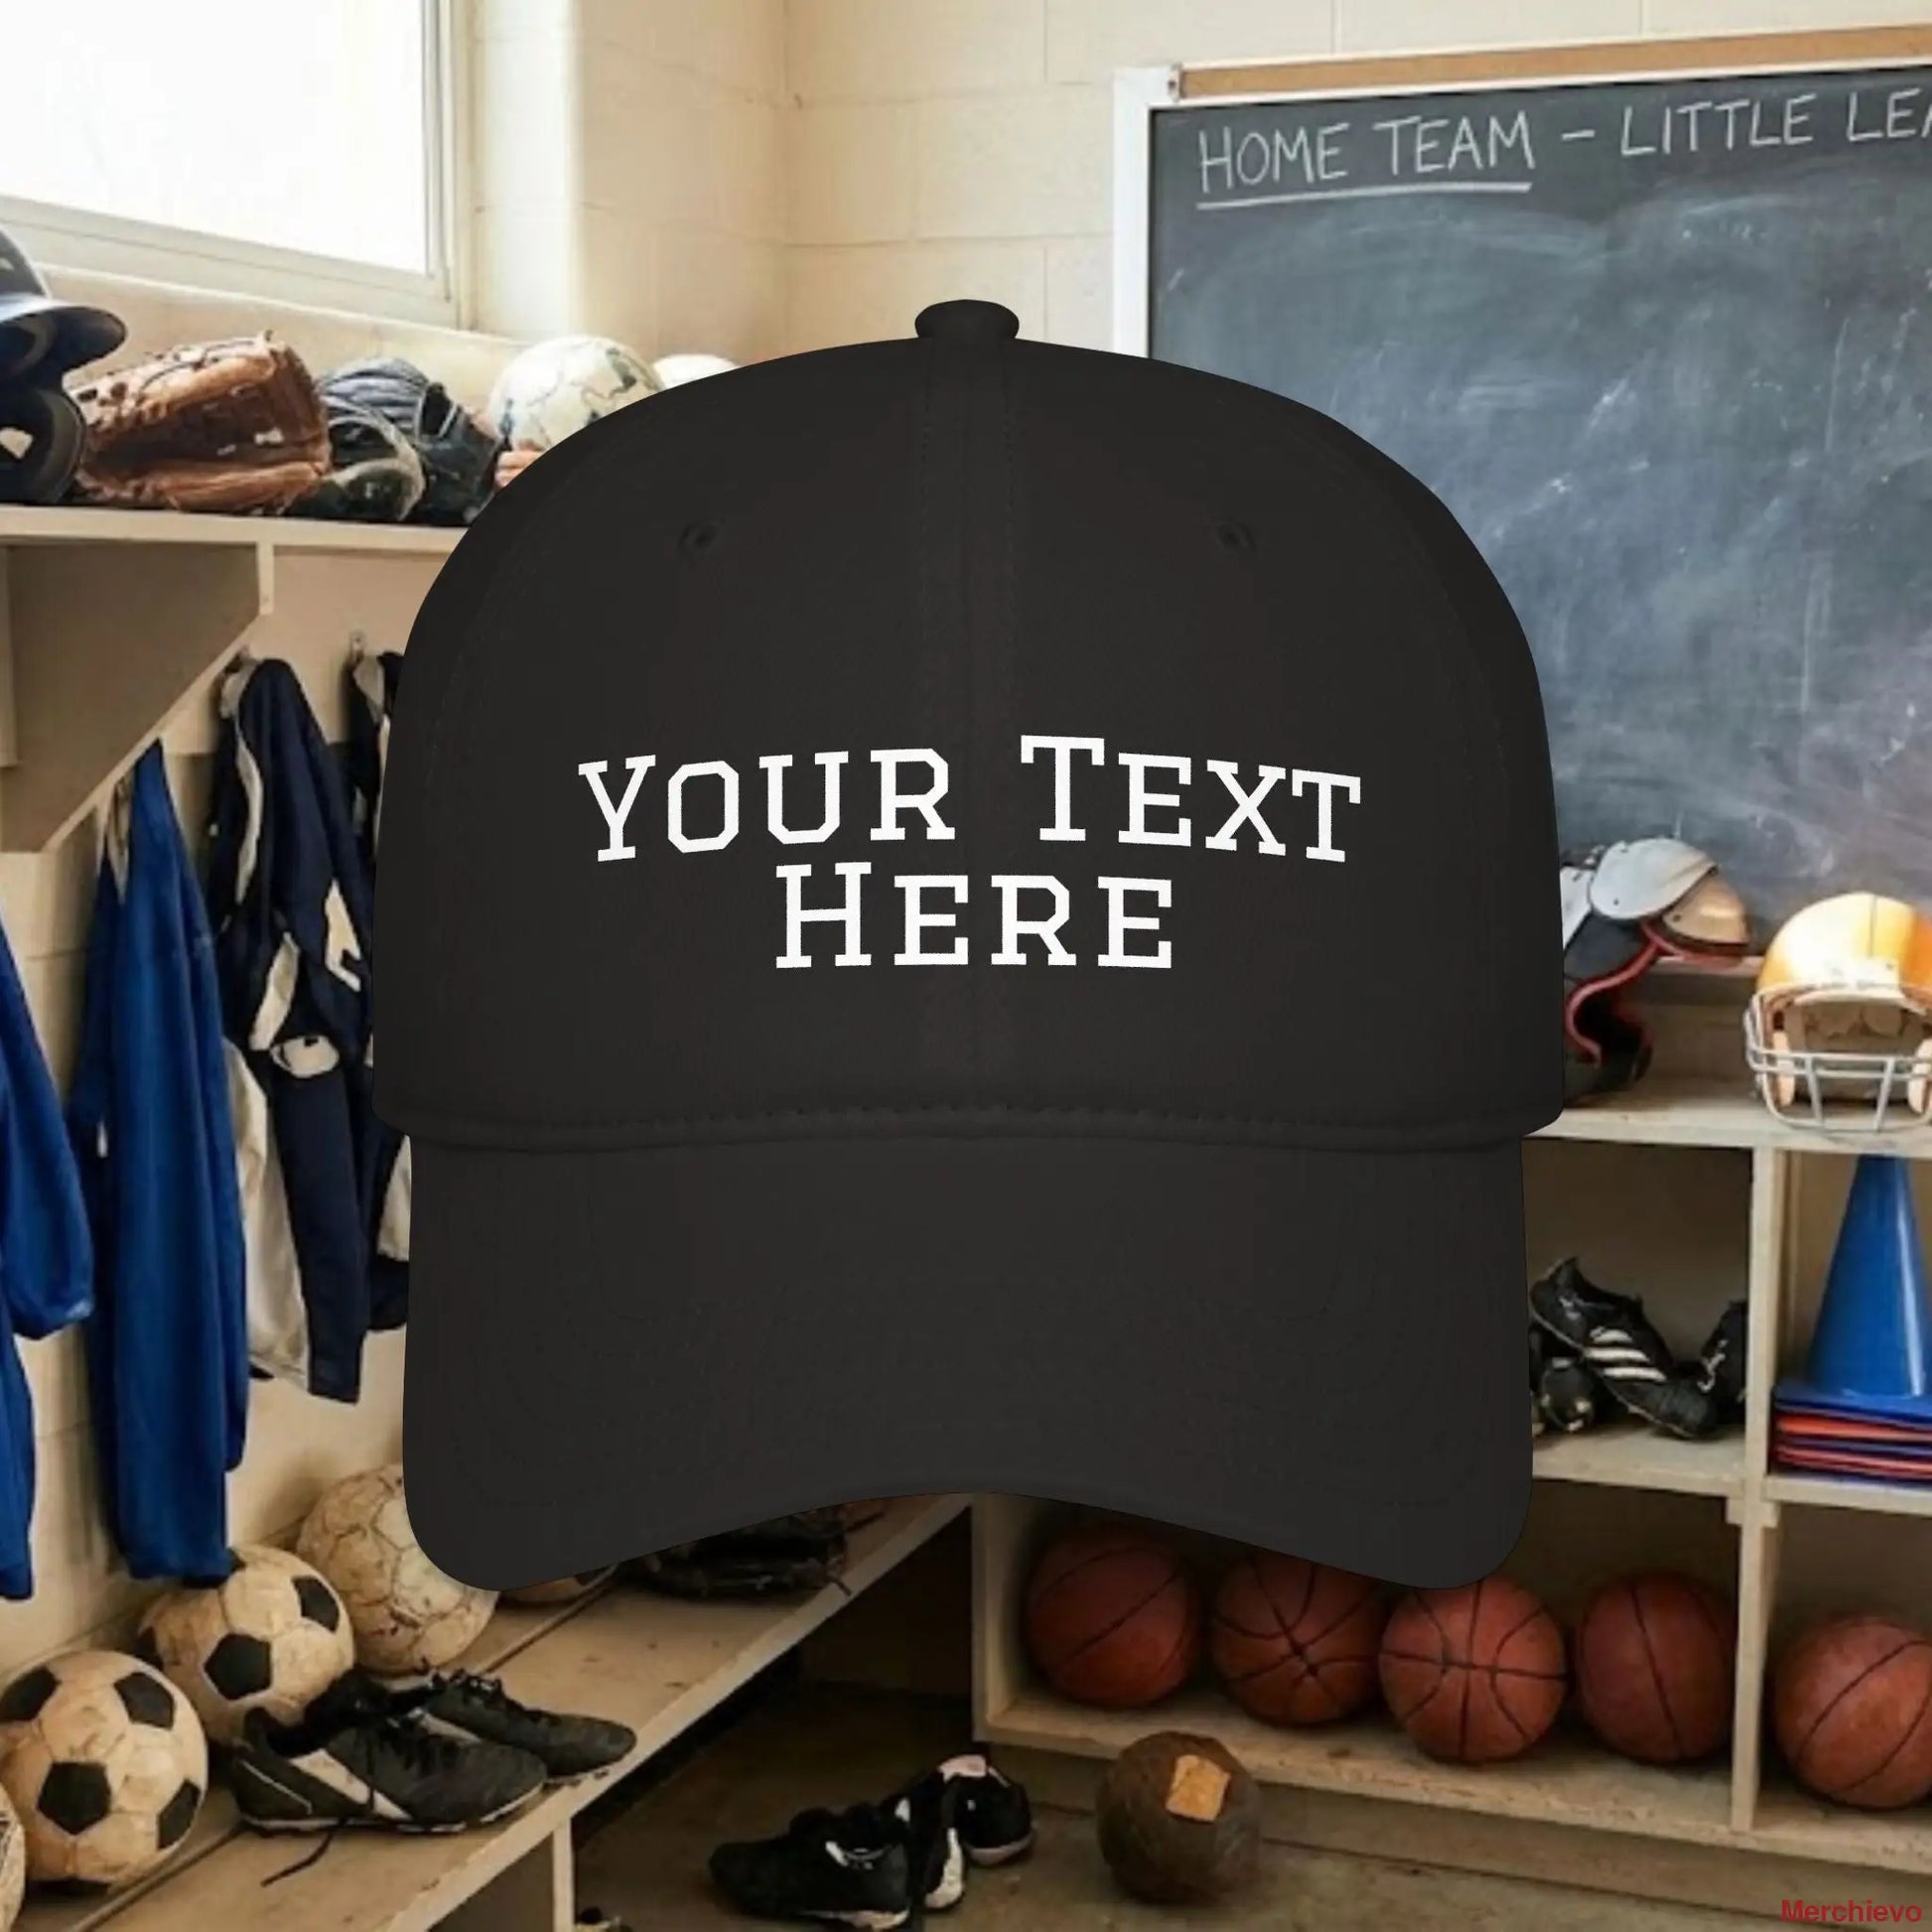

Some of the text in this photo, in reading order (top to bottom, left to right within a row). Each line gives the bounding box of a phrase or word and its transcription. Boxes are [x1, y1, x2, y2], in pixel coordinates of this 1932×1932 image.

[1197, 123, 1349, 193] HOME
[1372, 110, 1536, 177] TEAM
[1619, 94, 1816, 157] LITTLE
[578, 735, 1361, 863] YOUR TEXT
[775, 862, 1173, 969] HERE
